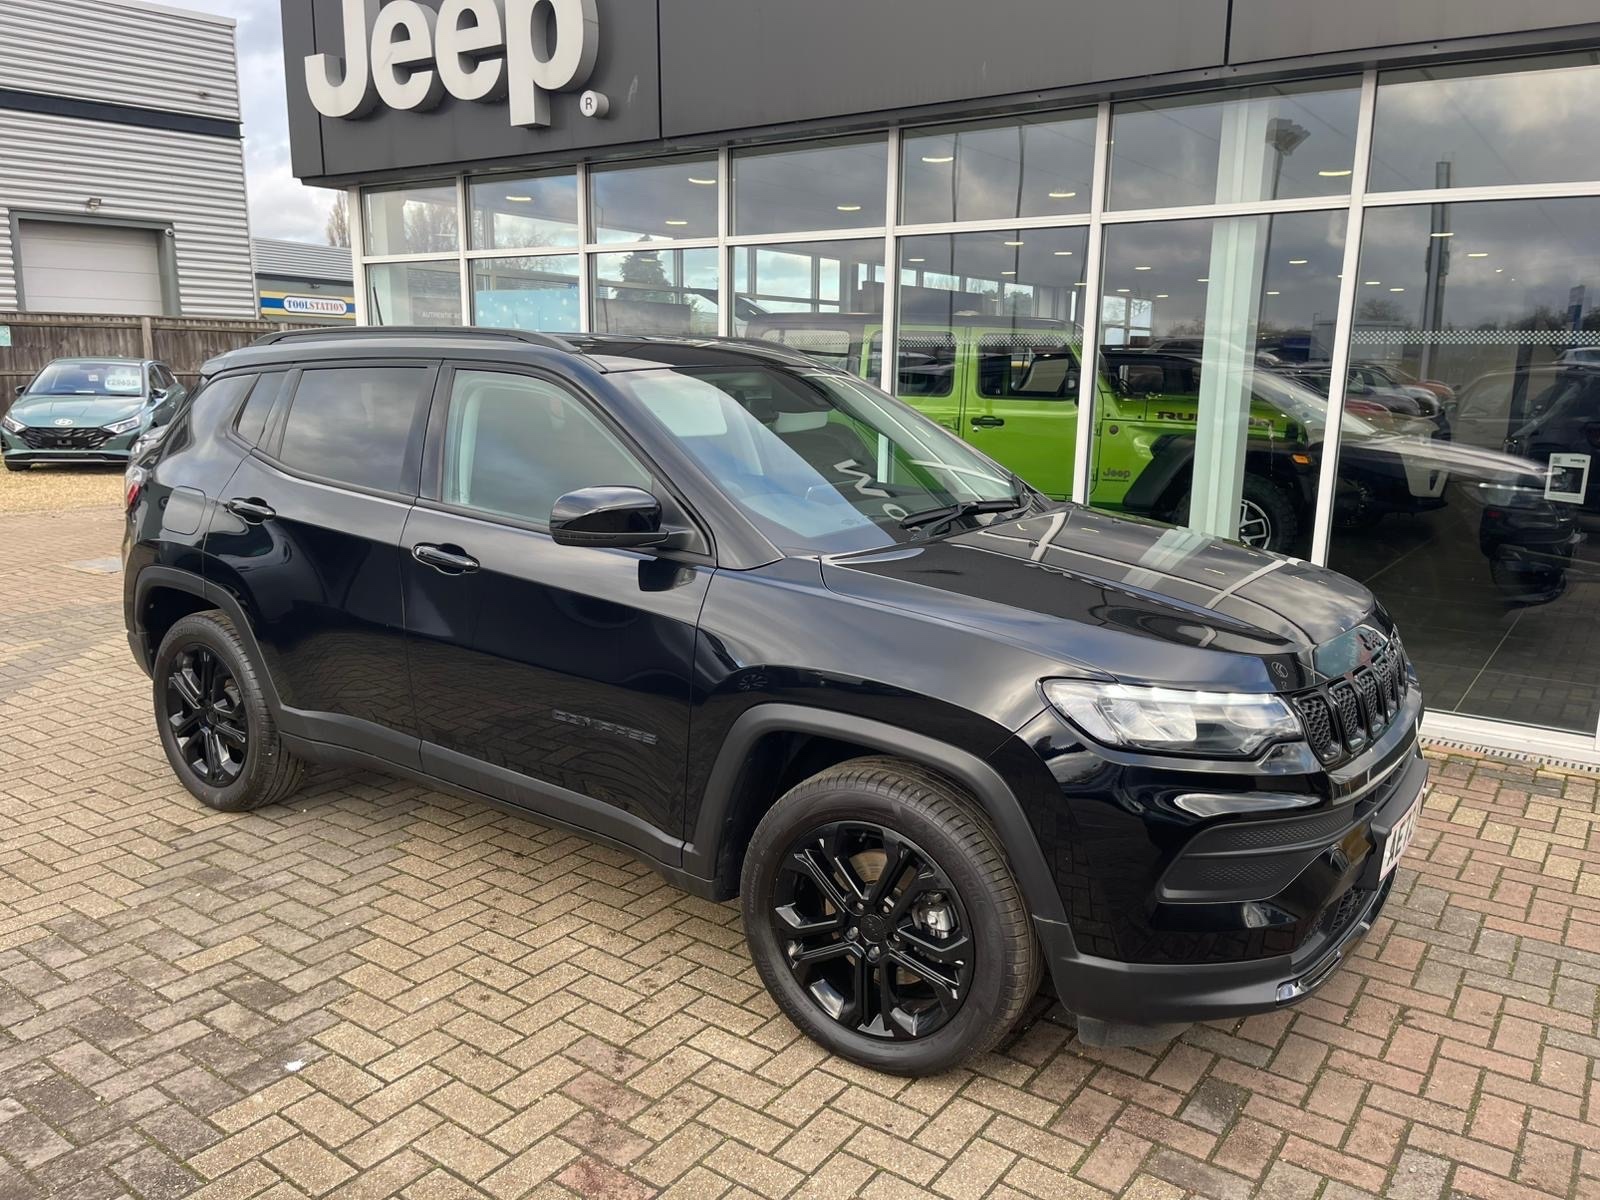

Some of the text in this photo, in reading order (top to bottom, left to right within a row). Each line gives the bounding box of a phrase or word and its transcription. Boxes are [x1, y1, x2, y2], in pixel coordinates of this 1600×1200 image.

[304, 0, 590, 127] Jeep
[286, 299, 344, 311] TOOLSTATION
[1102, 467, 1131, 479] Jeep
